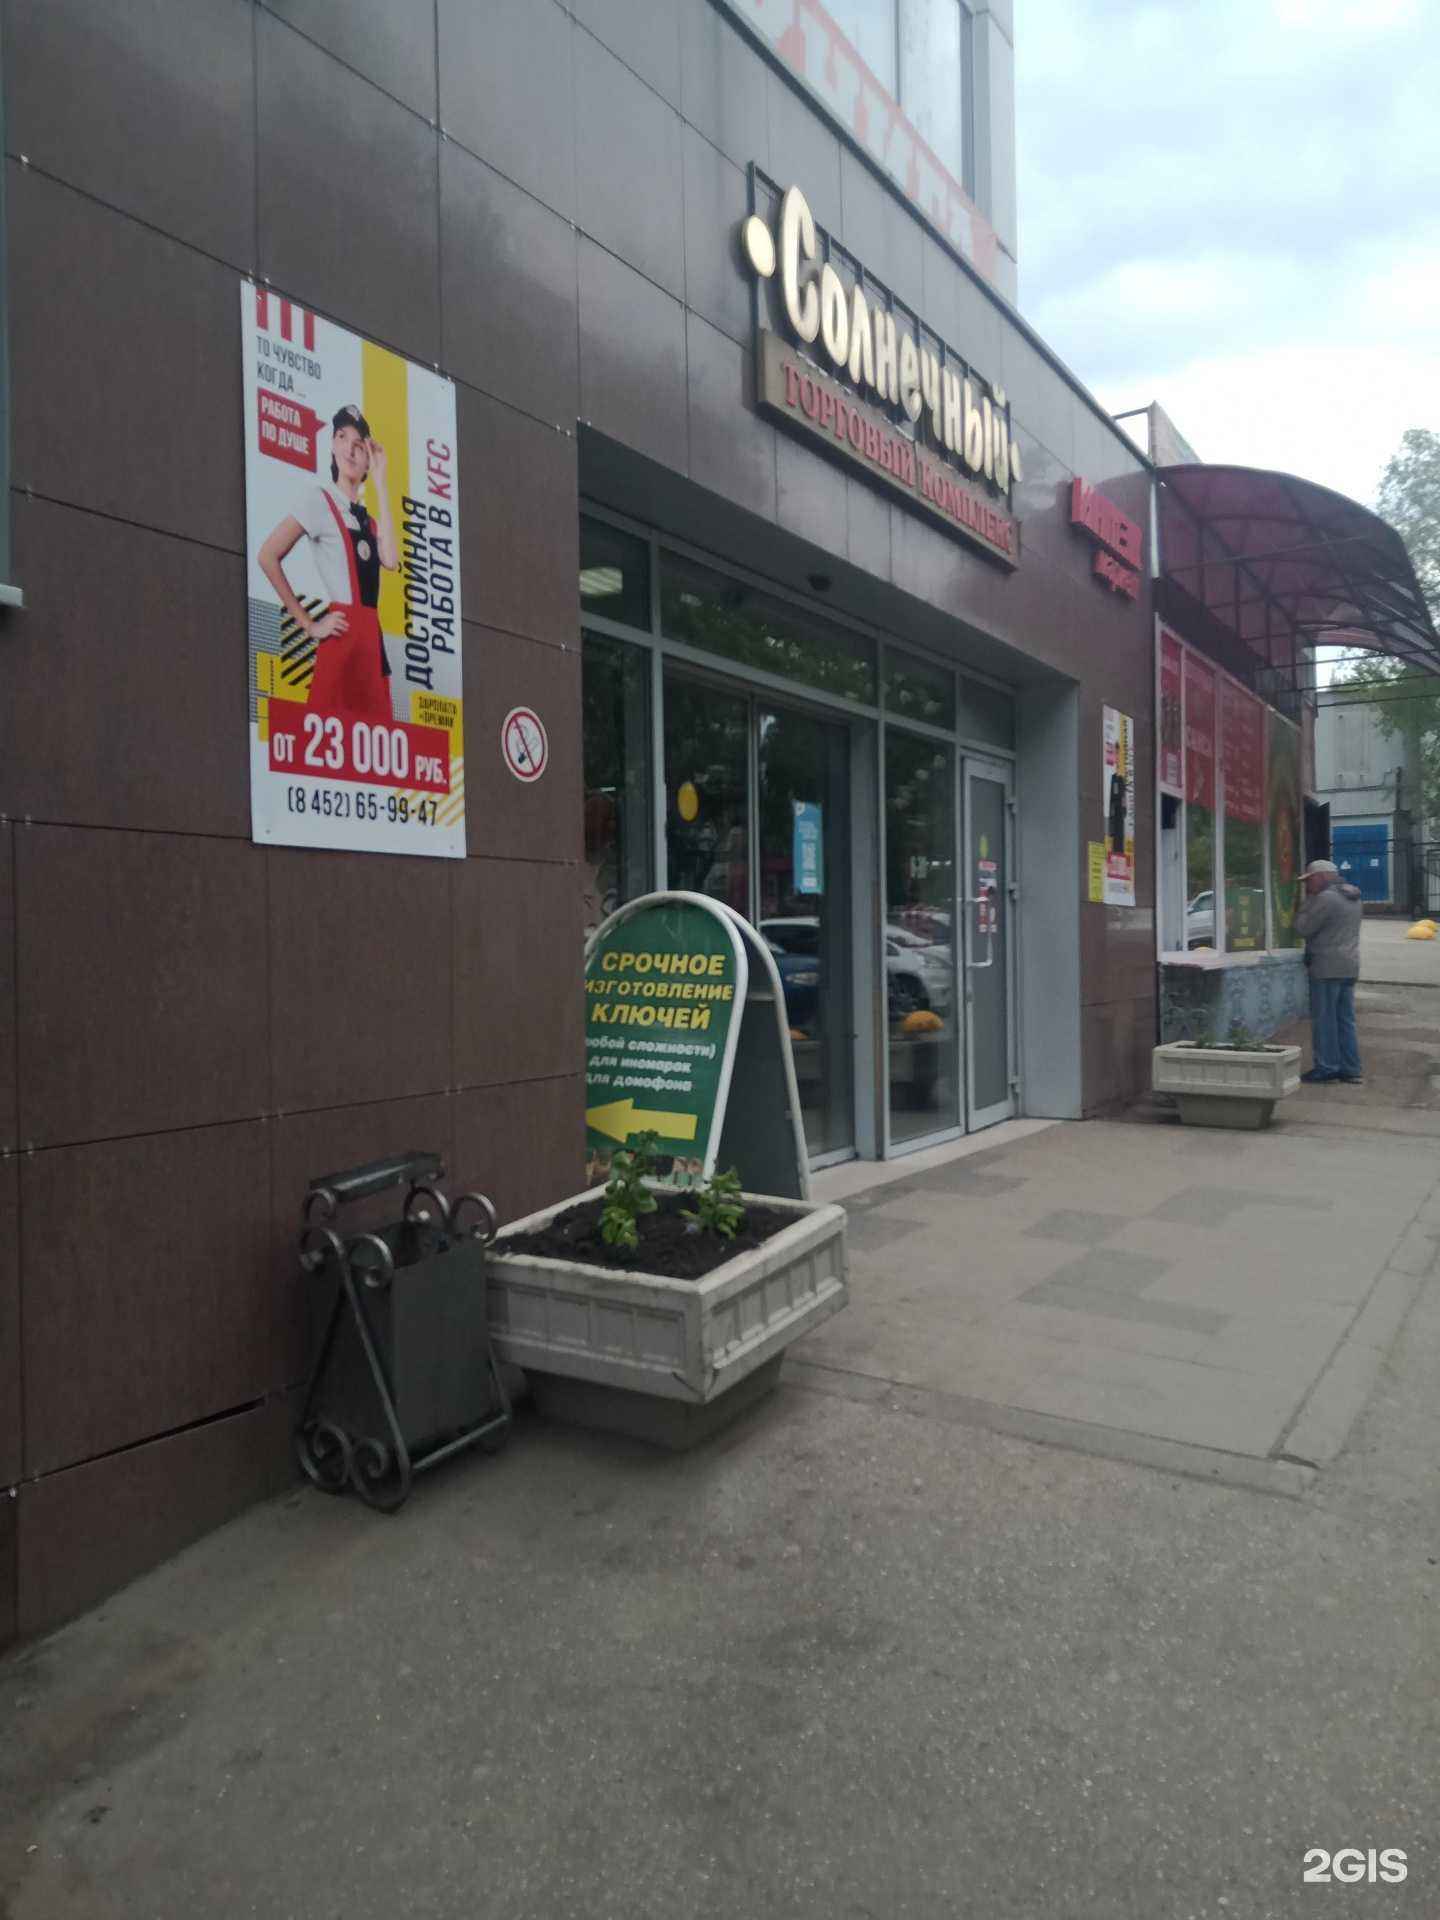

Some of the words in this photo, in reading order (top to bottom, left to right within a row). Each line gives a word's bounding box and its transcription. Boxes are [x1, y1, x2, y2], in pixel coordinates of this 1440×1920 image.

[256, 335, 271, 358] ТО
[273, 343, 322, 381] ЧУВСТВО
[261, 395, 302, 429] РАБОТА
[782, 356, 917, 489] ТОРГОВЫЙ
[261, 420, 277, 443] ПО
[278, 426, 311, 456] ДУШЕ
[426, 438, 452, 501] KFC
[428, 504, 453, 529] В
[398, 496, 434, 690] ДОСТОЙНАЯ
[430, 536, 455, 655] РАБОТА
[272, 733, 295, 763] ОТ
[303, 712, 345, 771] 23
[352, 721, 409, 780] 000
[415, 754, 448, 785] РУБ.
[355, 791, 439, 828] 65-99-47
[602, 952, 726, 976] СРОЧНОЕ
[585, 978, 735, 1001] ИЗГОТОВЛЕНИЕ
[592, 1003, 711, 1030] КЛЮЧЕЙ
[589, 1055, 618, 1067] для
